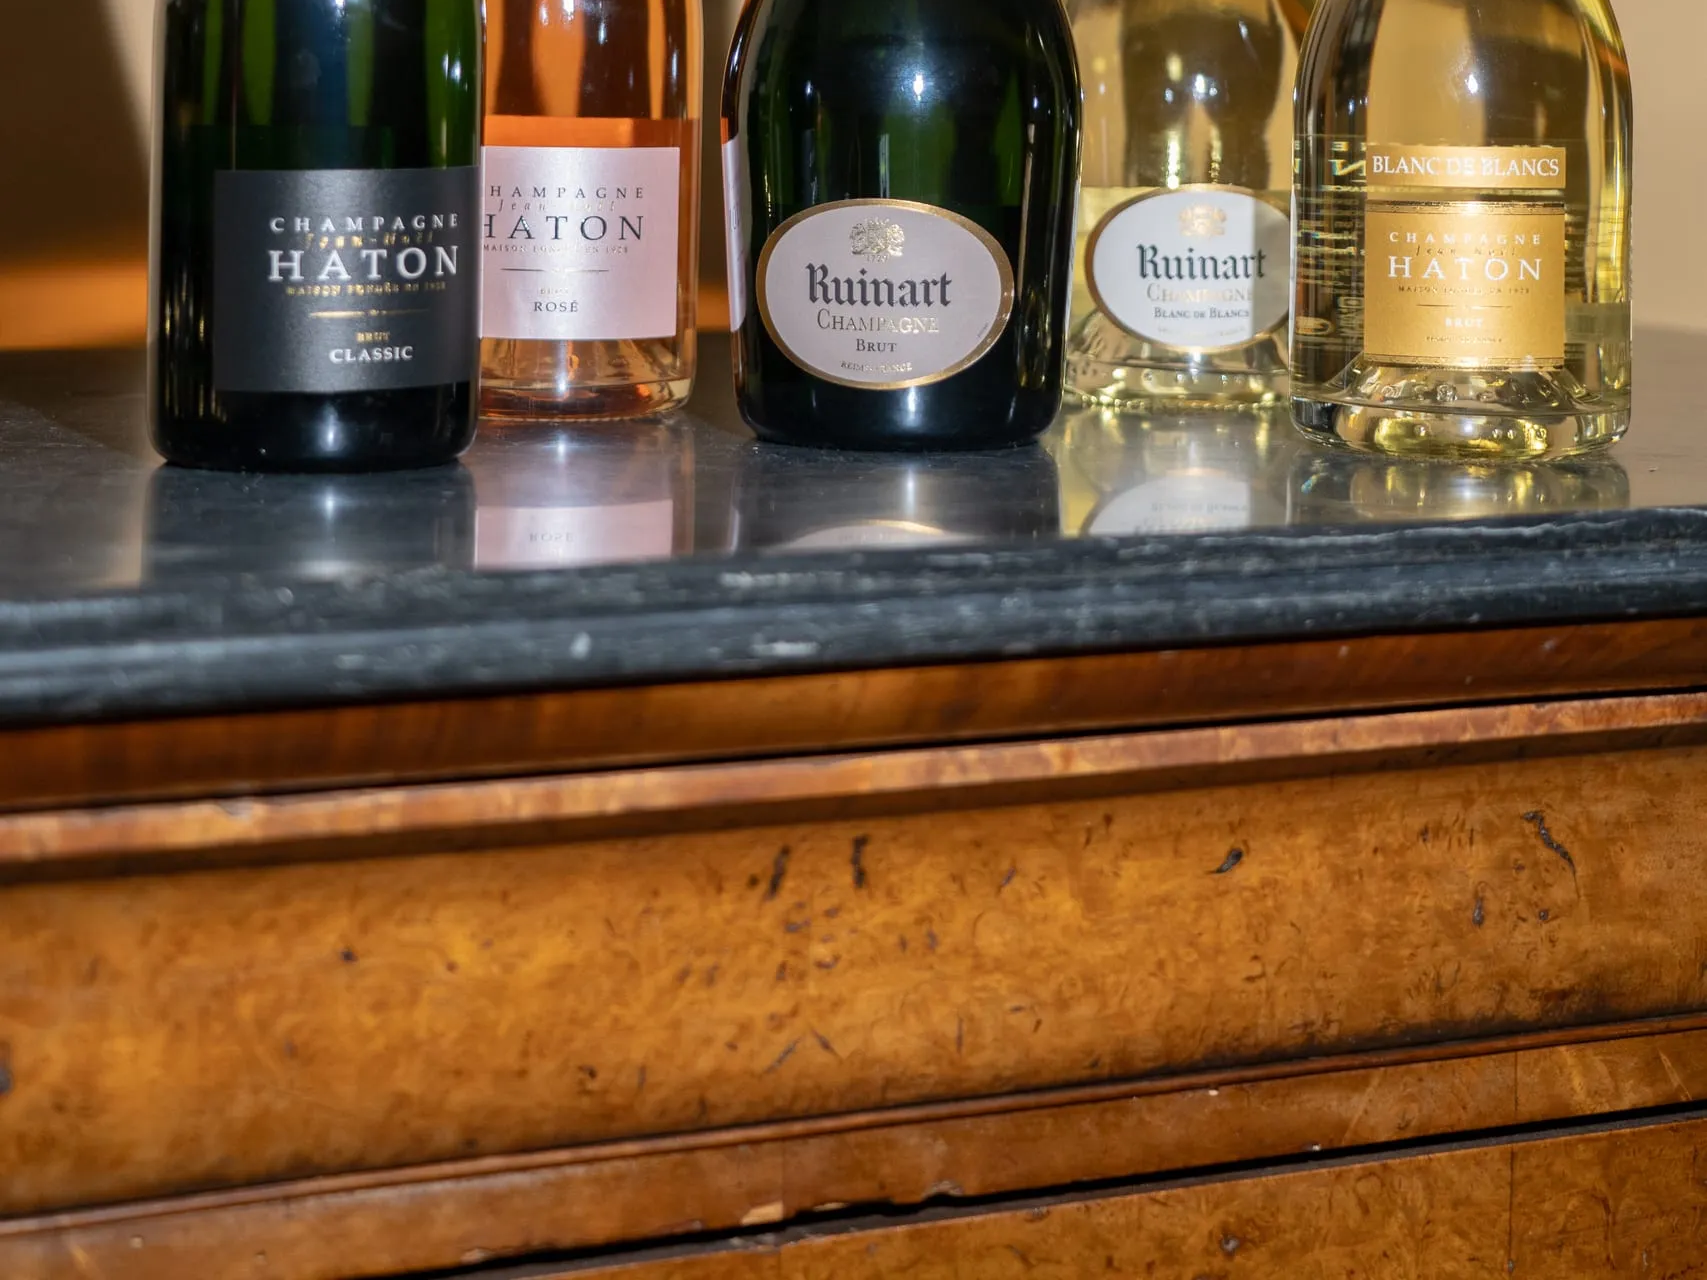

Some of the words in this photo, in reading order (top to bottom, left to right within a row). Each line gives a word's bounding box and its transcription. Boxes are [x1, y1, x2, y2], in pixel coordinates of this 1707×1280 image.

[1372, 155, 1441, 175] BLANC
[1446, 157, 1476, 176] DE
[1481, 157, 1561, 177] BLANCS
[489, 184, 645, 200] HAMPAGNE
[269, 213, 459, 234] CHAMPAGNE
[1389, 230, 1542, 246] CHAMPAGNE
[267, 245, 459, 282] HATON
[1136, 242, 1267, 280] Ruinart
[1387, 255, 1543, 282] HATON
[805, 262, 953, 308] Ruinart
[533, 299, 580, 313] ROSÉ
[329, 345, 414, 365] CLASSIC
